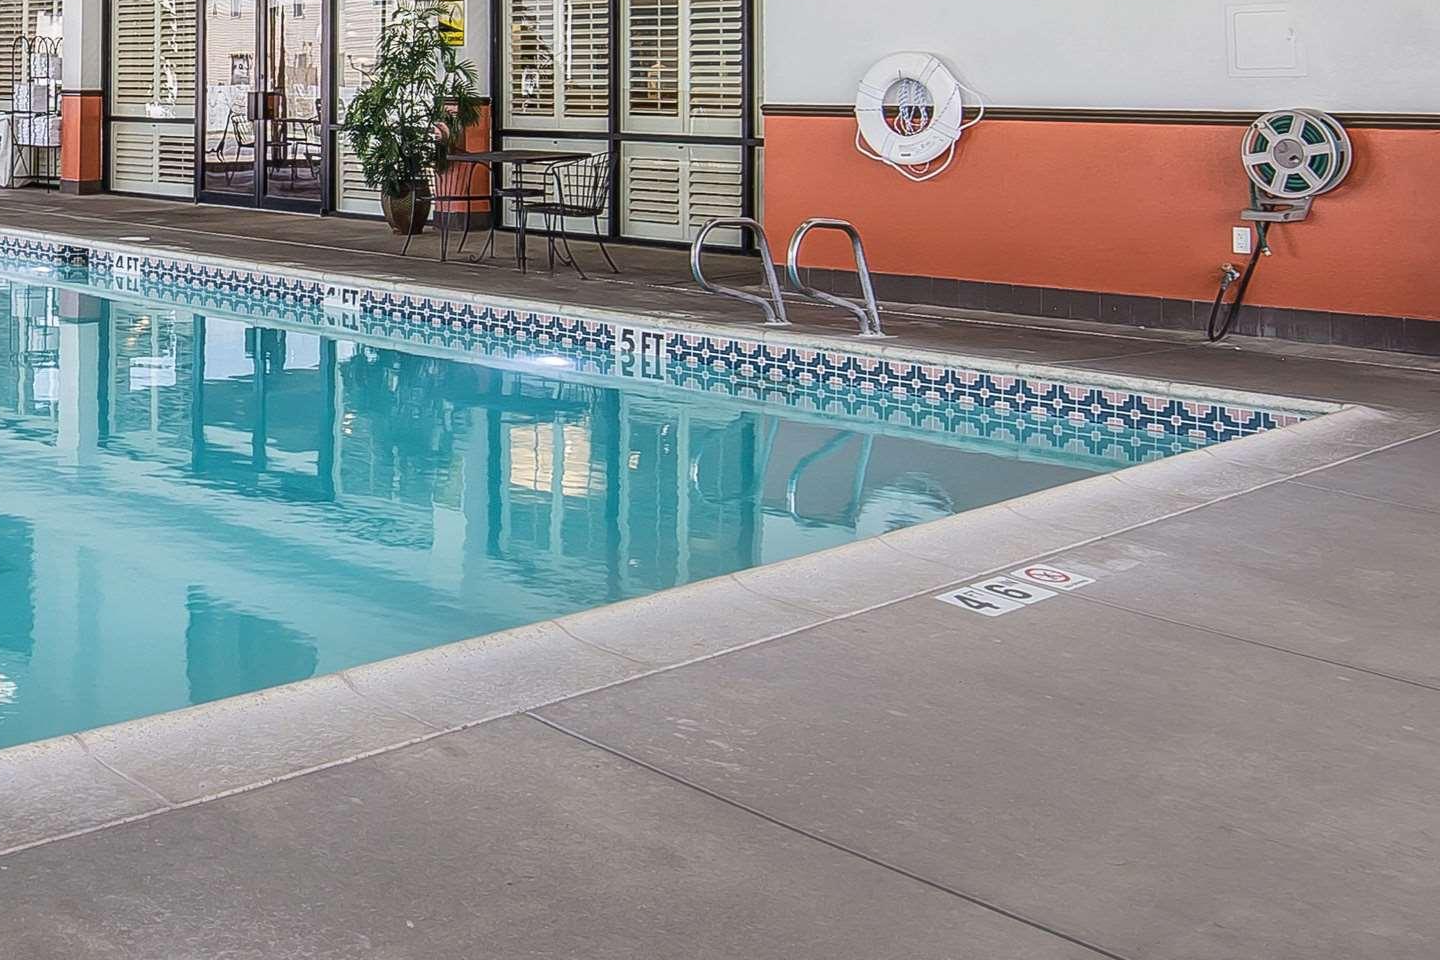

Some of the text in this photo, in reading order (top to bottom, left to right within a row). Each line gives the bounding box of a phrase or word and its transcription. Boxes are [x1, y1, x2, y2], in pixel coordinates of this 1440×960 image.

[115, 255, 139, 271] 4 FT
[342, 288, 359, 306] FT
[621, 328, 664, 356] 5 FT
[953, 594, 1001, 610] 4
[983, 583, 1033, 600] 6
